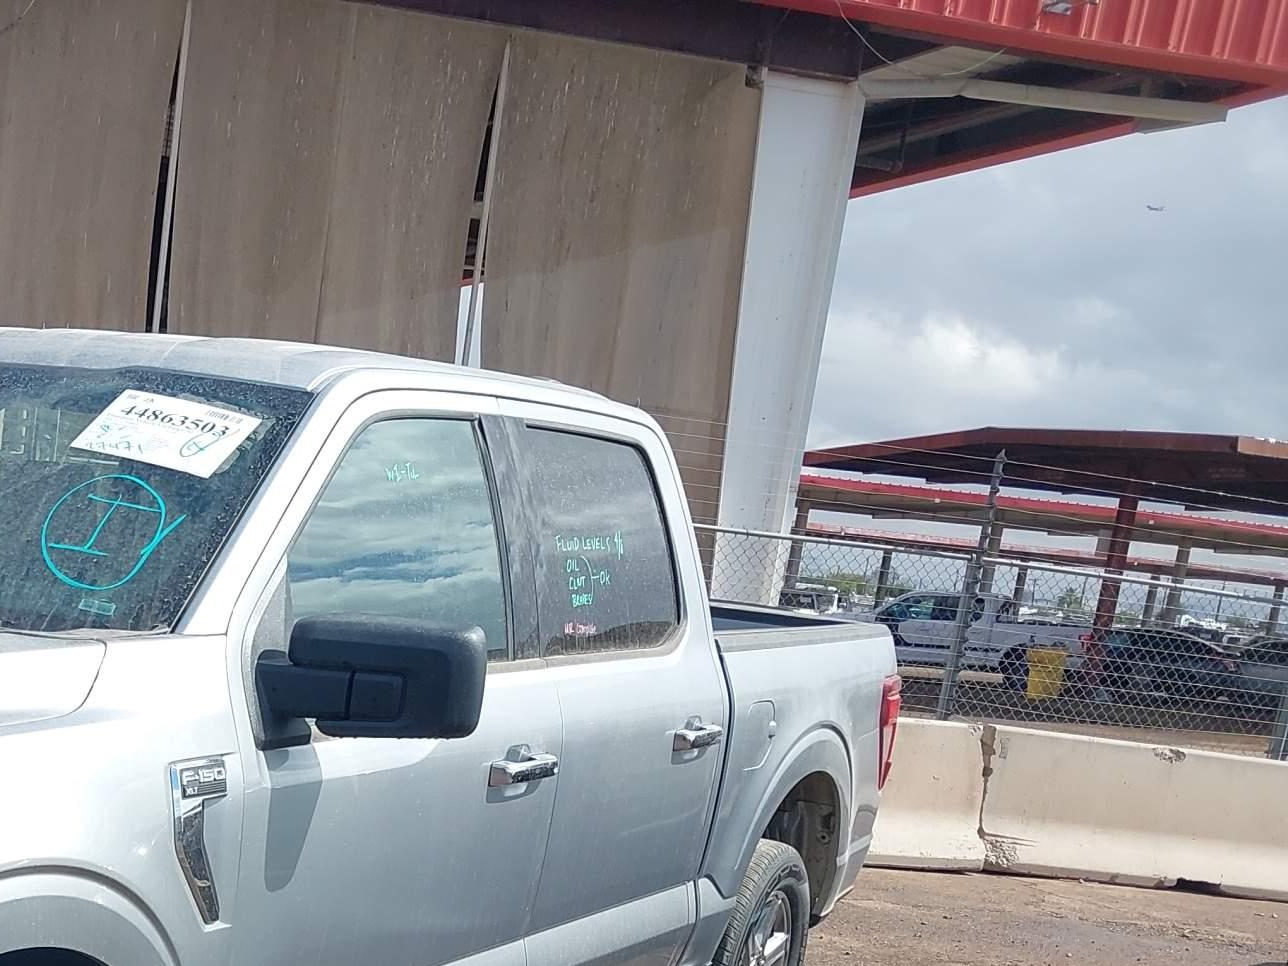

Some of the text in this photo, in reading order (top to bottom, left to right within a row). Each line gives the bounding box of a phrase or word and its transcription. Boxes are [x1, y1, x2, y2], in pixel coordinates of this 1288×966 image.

[120, 405, 230, 436] 44863503
[555, 534, 580, 552] FLUID
[582, 536, 611, 552] LEVELS
[566, 559, 580, 573] OIL
[182, 767, 226, 785] F-150
[185, 786, 199, 796] XLT
